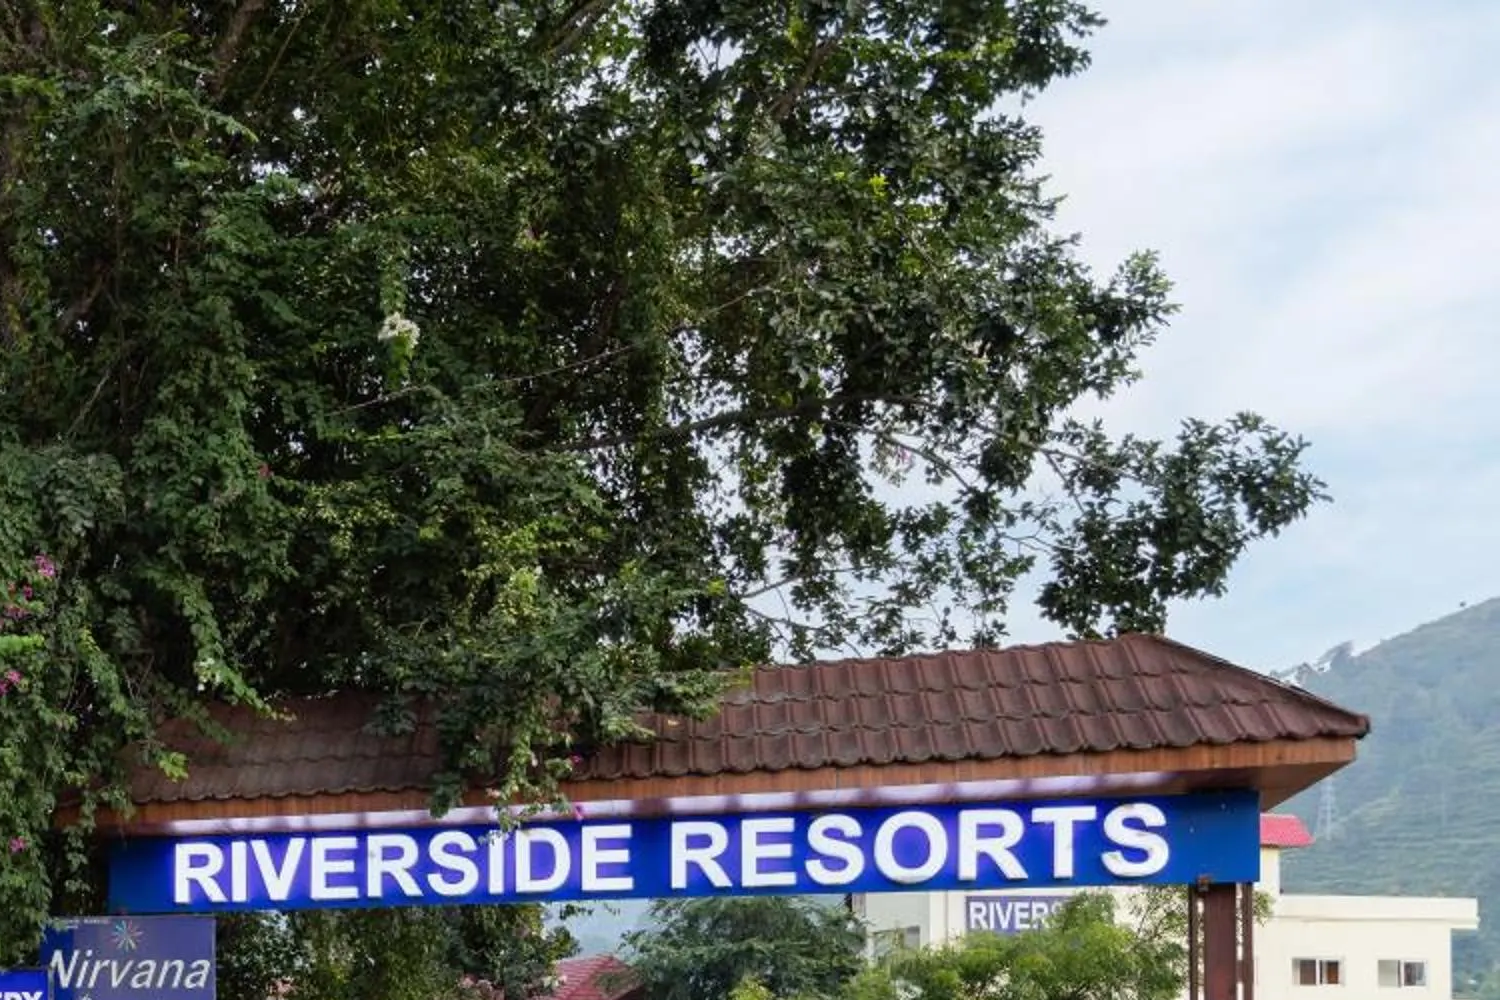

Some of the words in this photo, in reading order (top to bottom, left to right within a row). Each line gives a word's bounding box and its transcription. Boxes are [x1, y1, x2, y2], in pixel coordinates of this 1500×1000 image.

[174, 824, 634, 904] RIVERSIDE
[670, 802, 1170, 889] RESORTS
[50, 949, 211, 989] Nirvana
